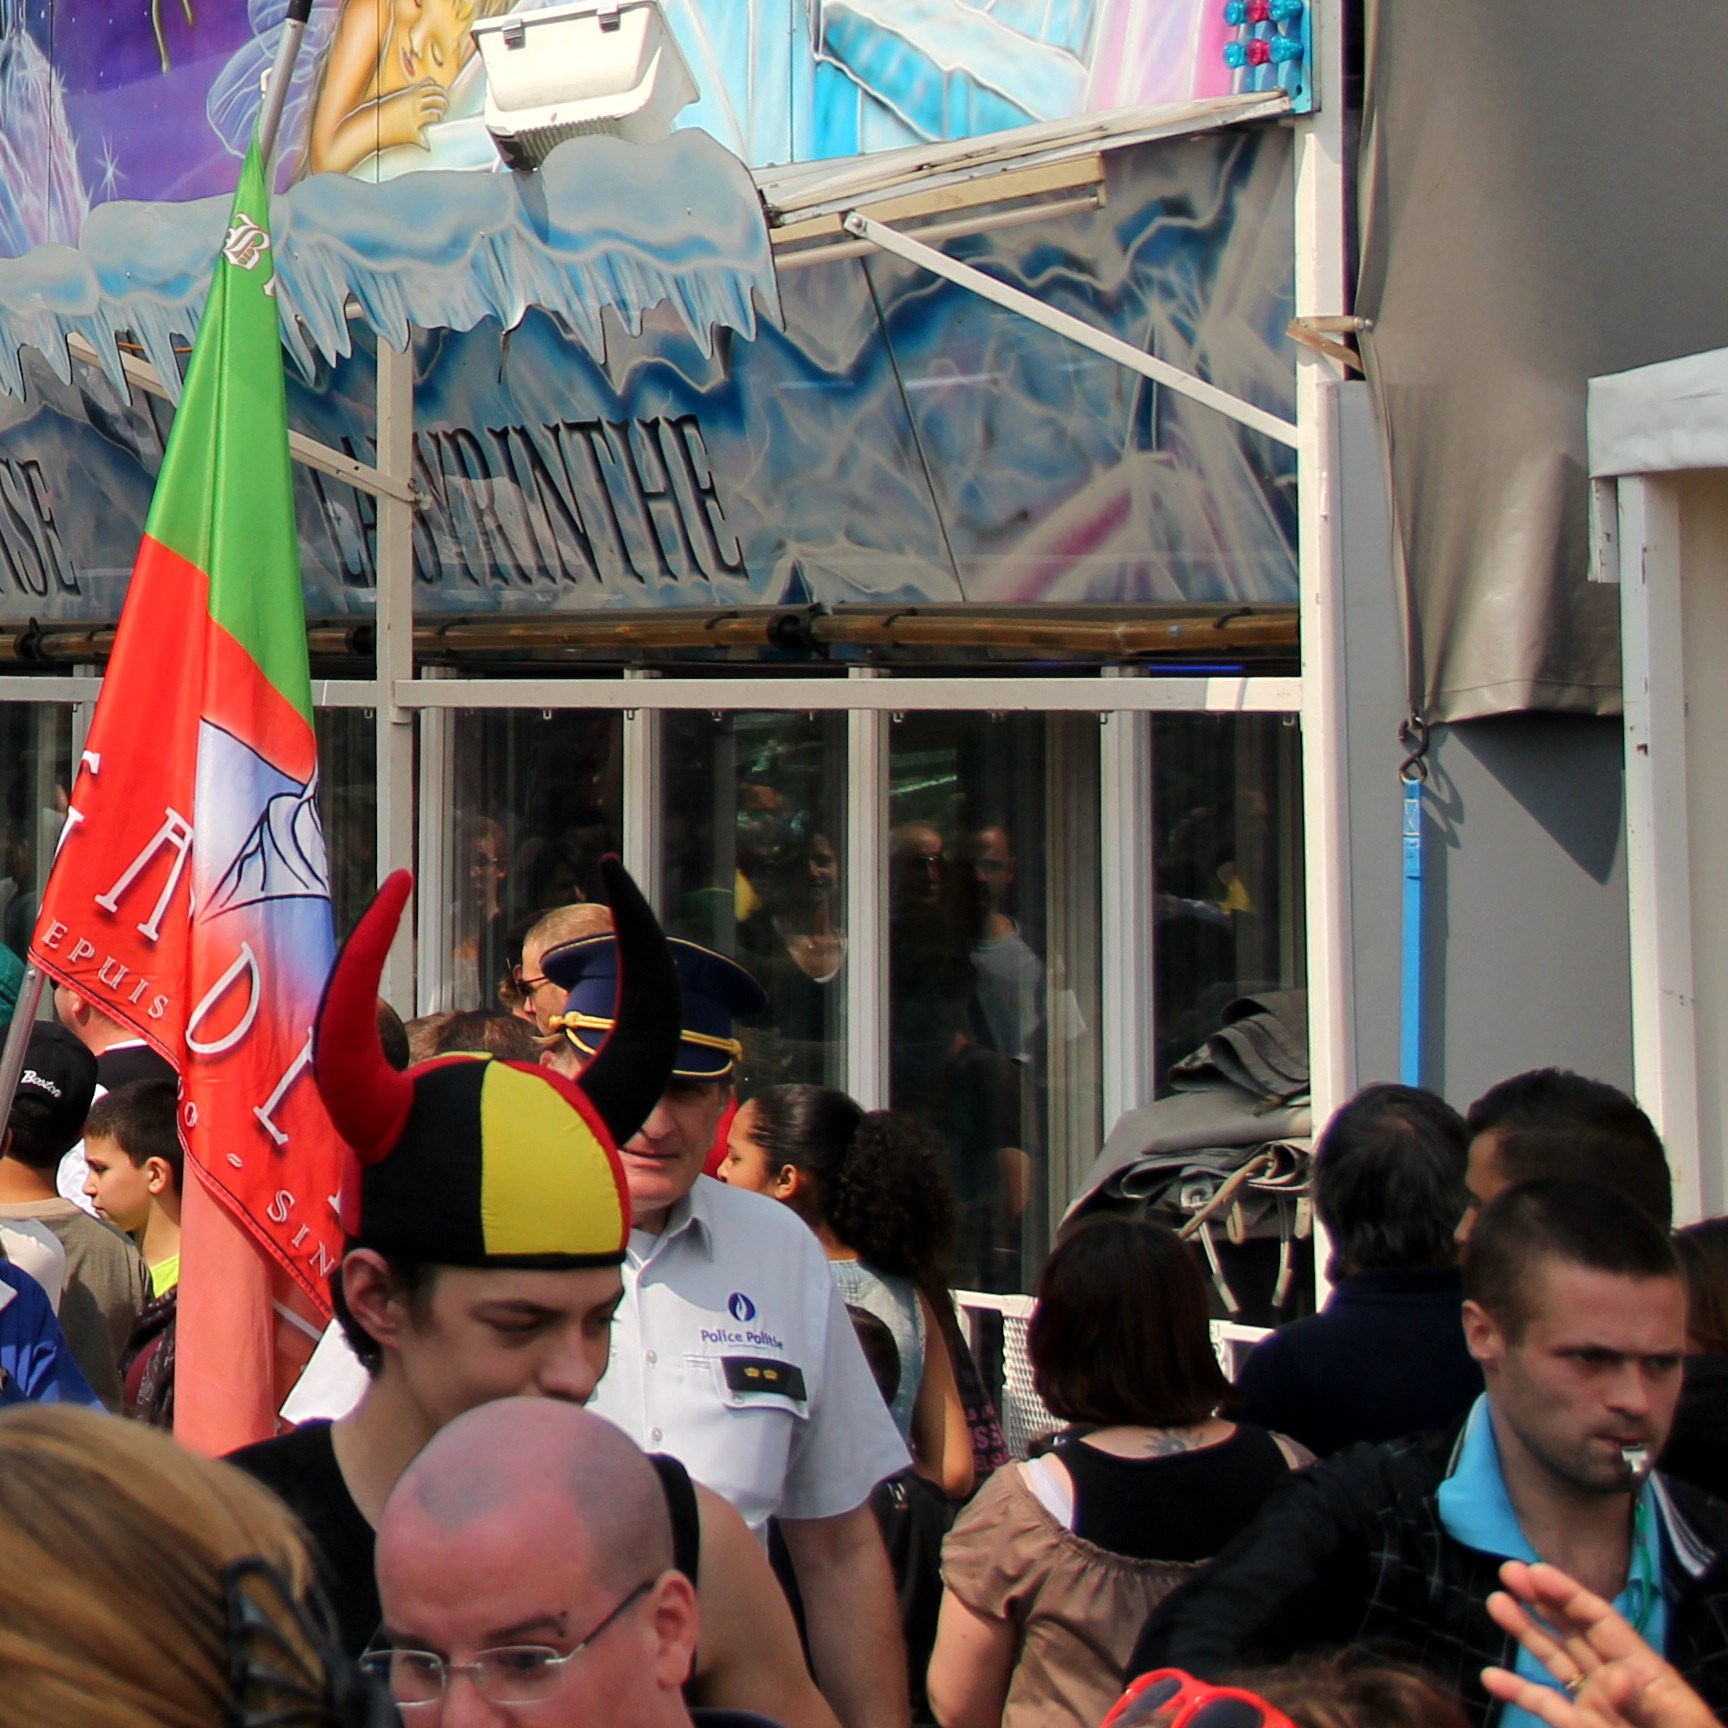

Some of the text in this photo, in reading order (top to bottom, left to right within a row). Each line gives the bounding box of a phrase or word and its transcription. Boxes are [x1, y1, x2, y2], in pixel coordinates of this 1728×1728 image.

[38, 917, 169, 1020] EPUIS
[21, 1069, 62, 1098] Boston
[700, 1328, 784, 1350] Police Politie
